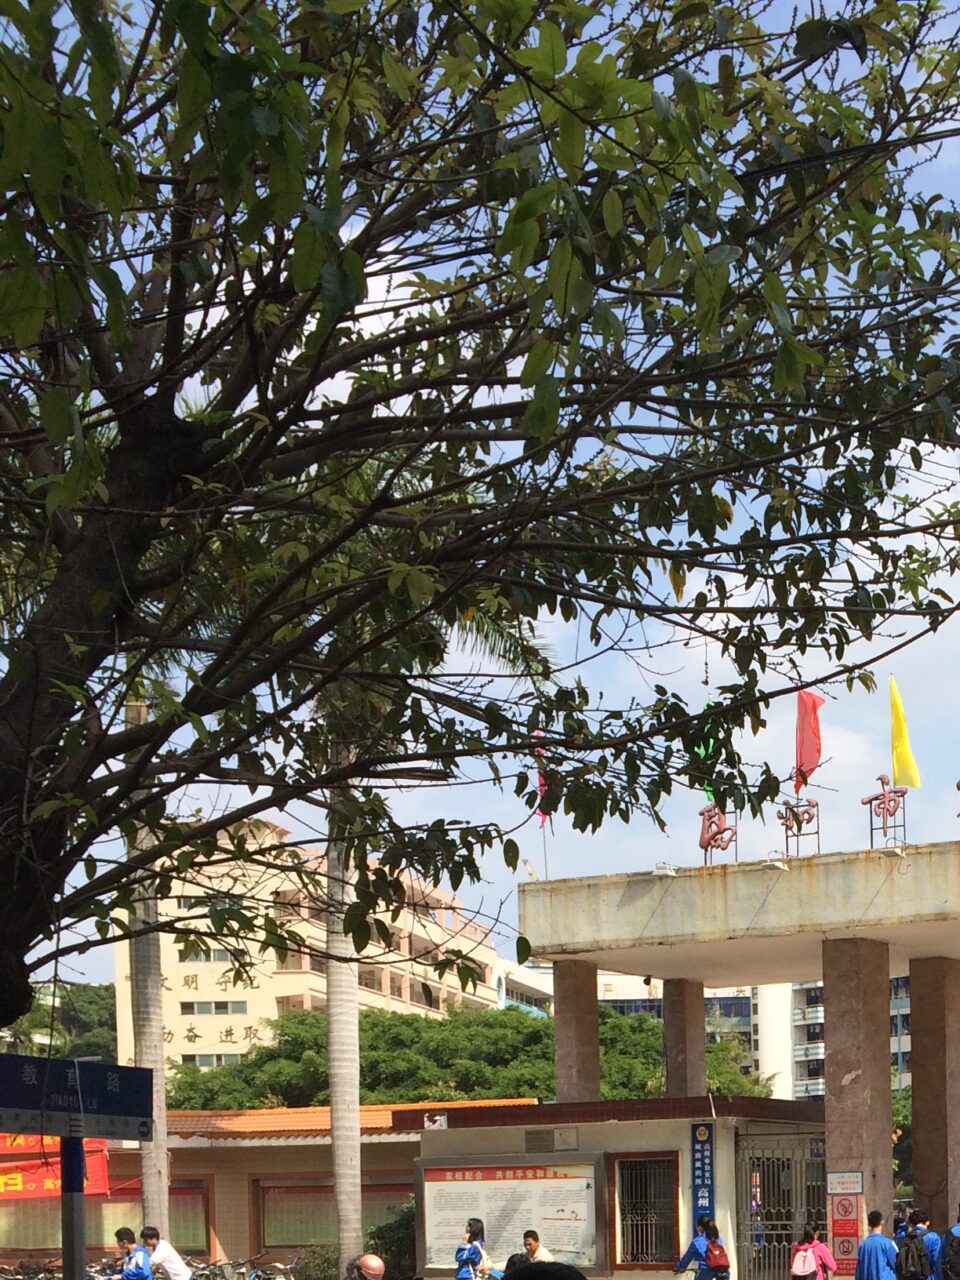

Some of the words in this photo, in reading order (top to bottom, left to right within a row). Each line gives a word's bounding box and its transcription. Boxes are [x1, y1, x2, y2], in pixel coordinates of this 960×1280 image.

[219, 1025, 264, 1044] 进取
[21, 1063, 121, 1093] 教育路
